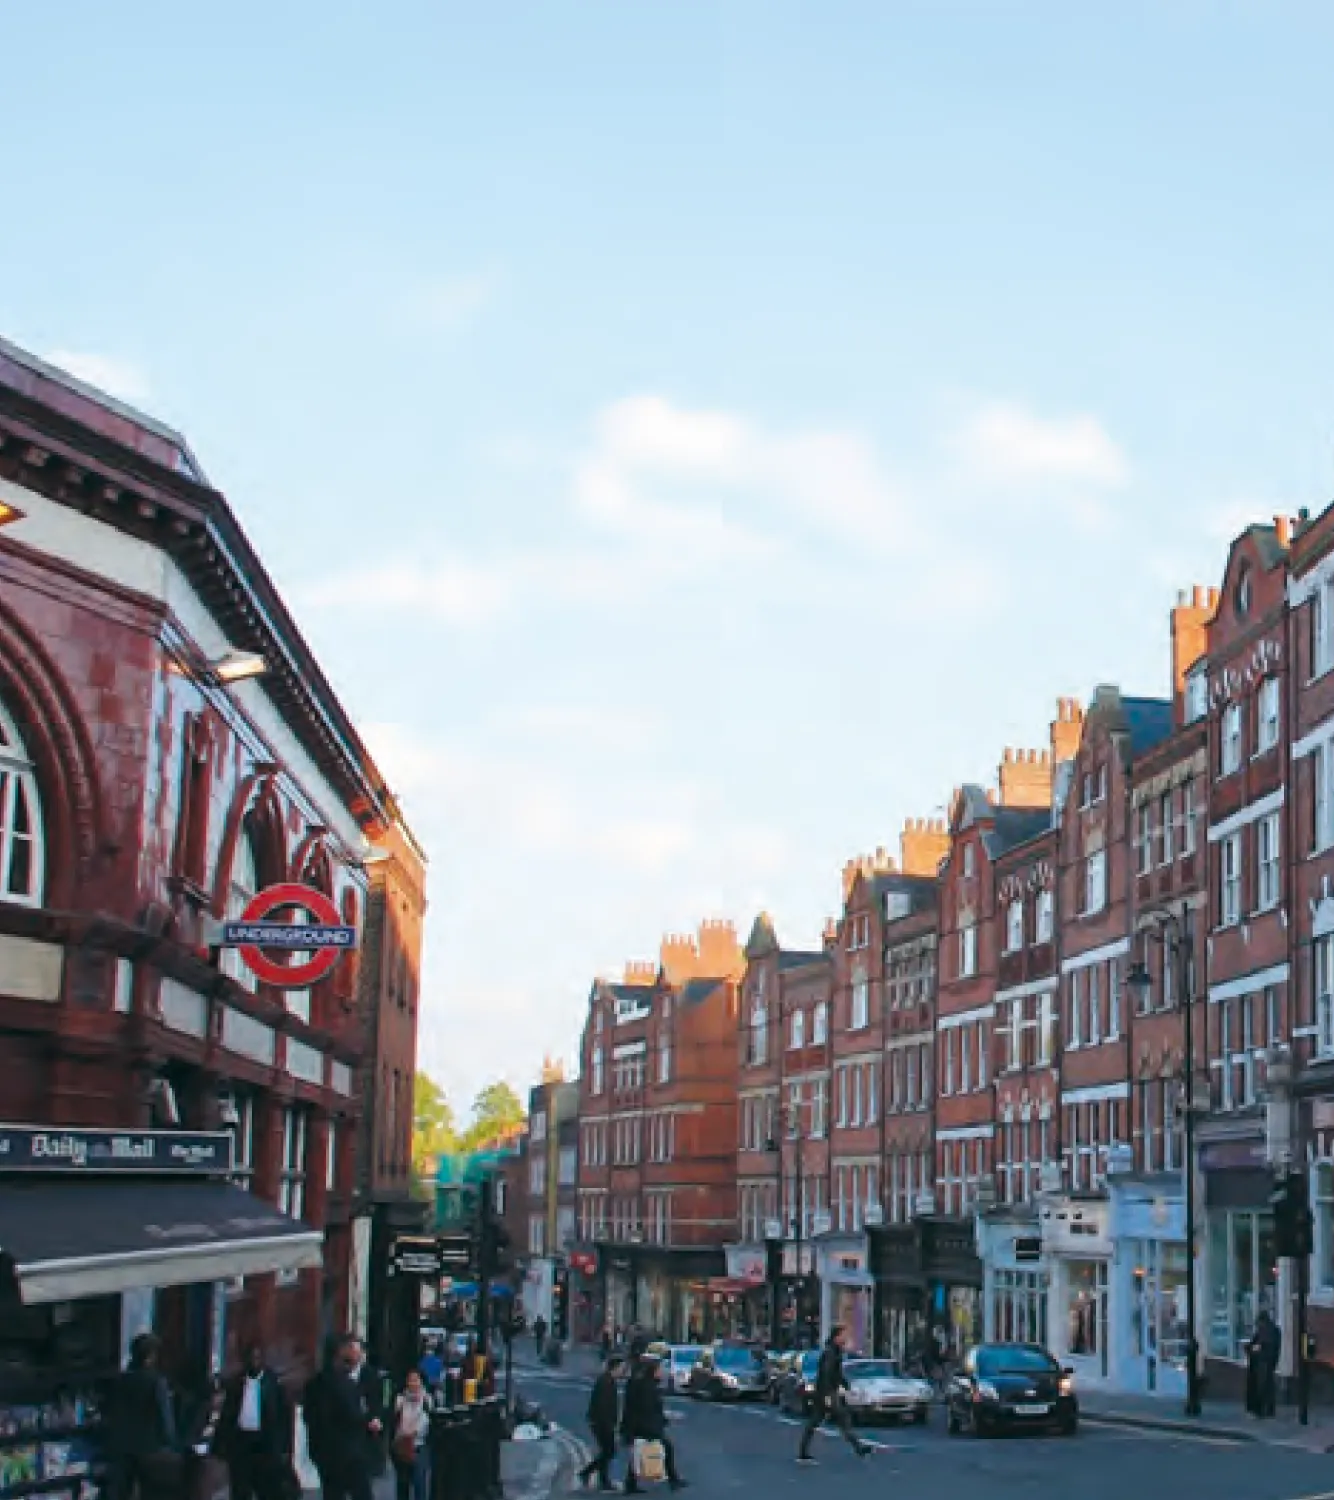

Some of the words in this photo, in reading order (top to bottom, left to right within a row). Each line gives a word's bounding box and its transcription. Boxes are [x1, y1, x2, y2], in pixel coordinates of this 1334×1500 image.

[227, 926, 351, 944] UNDERGROUND
[31, 1134, 87, 1165] Daily
[111, 1137, 155, 1157] Mail
